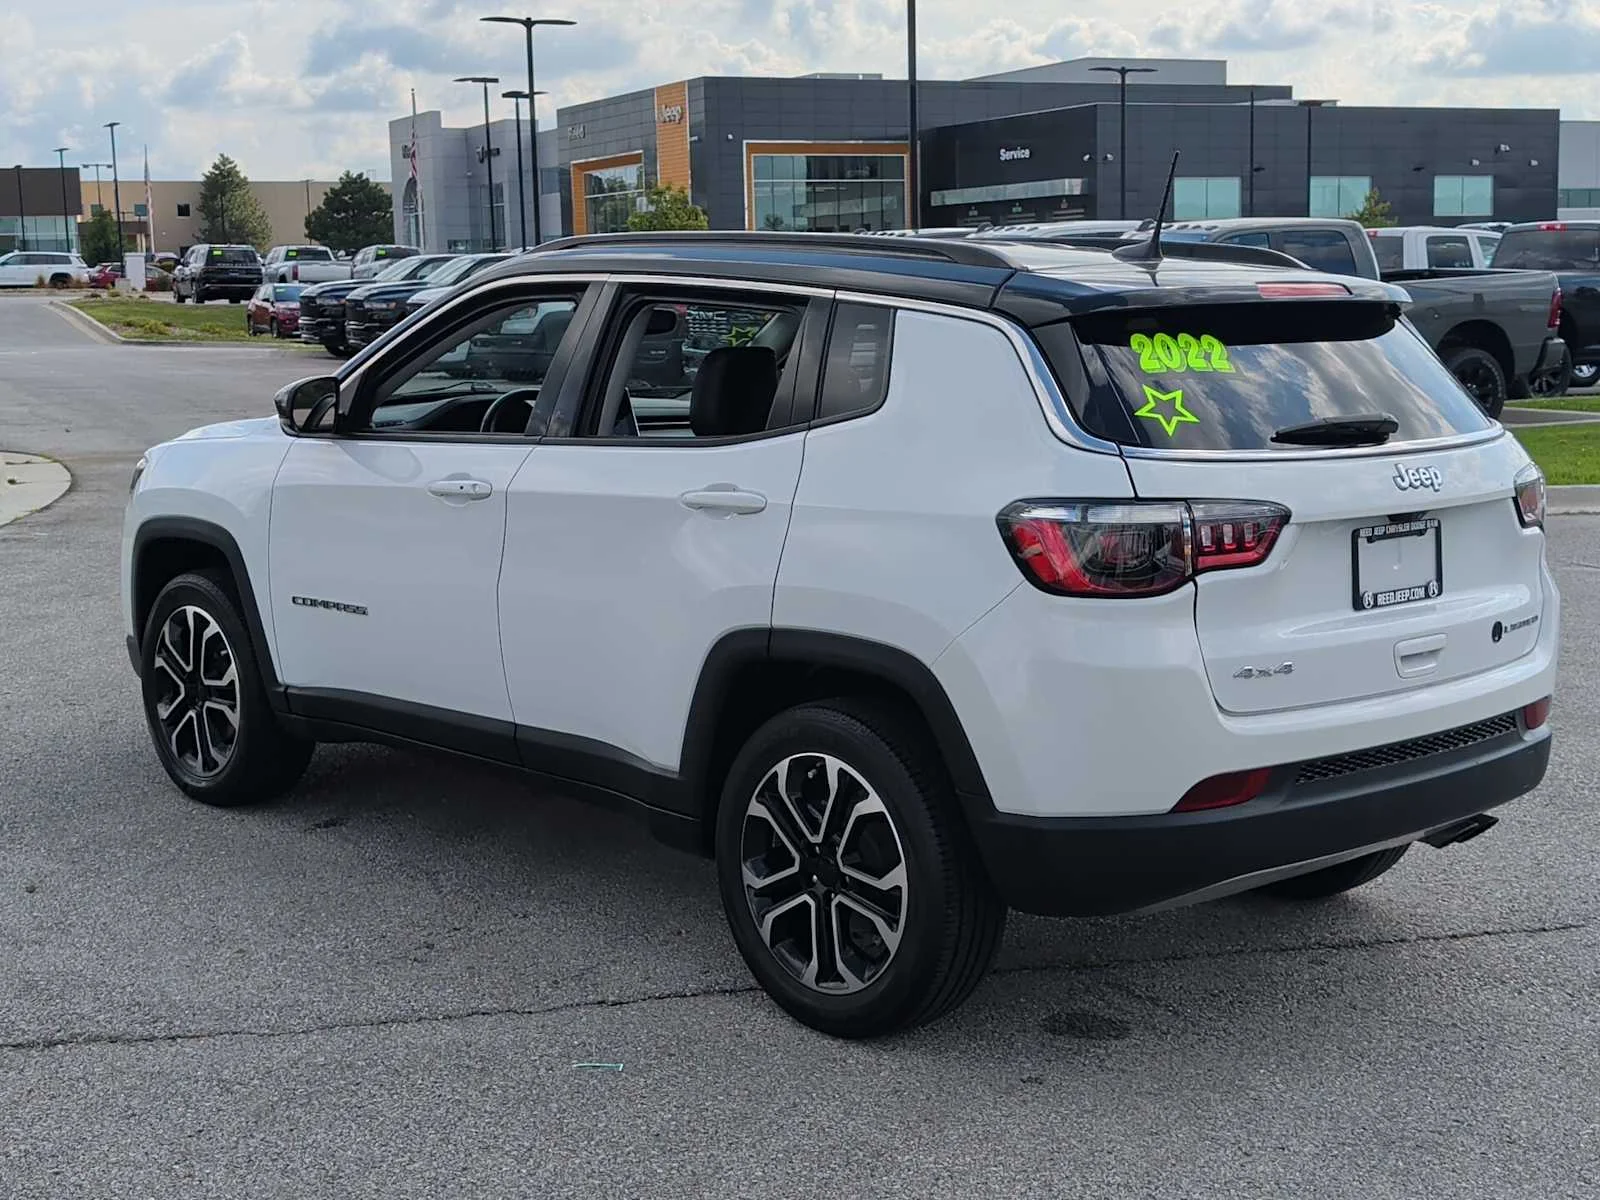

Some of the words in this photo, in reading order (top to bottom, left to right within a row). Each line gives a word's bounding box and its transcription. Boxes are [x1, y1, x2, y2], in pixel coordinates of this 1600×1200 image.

[660, 104, 682, 124] Jeep
[999, 147, 1031, 161] Service
[1130, 332, 1236, 374] 2022
[1393, 463, 1442, 492] Jeep
[292, 596, 369, 615] COMPASS
